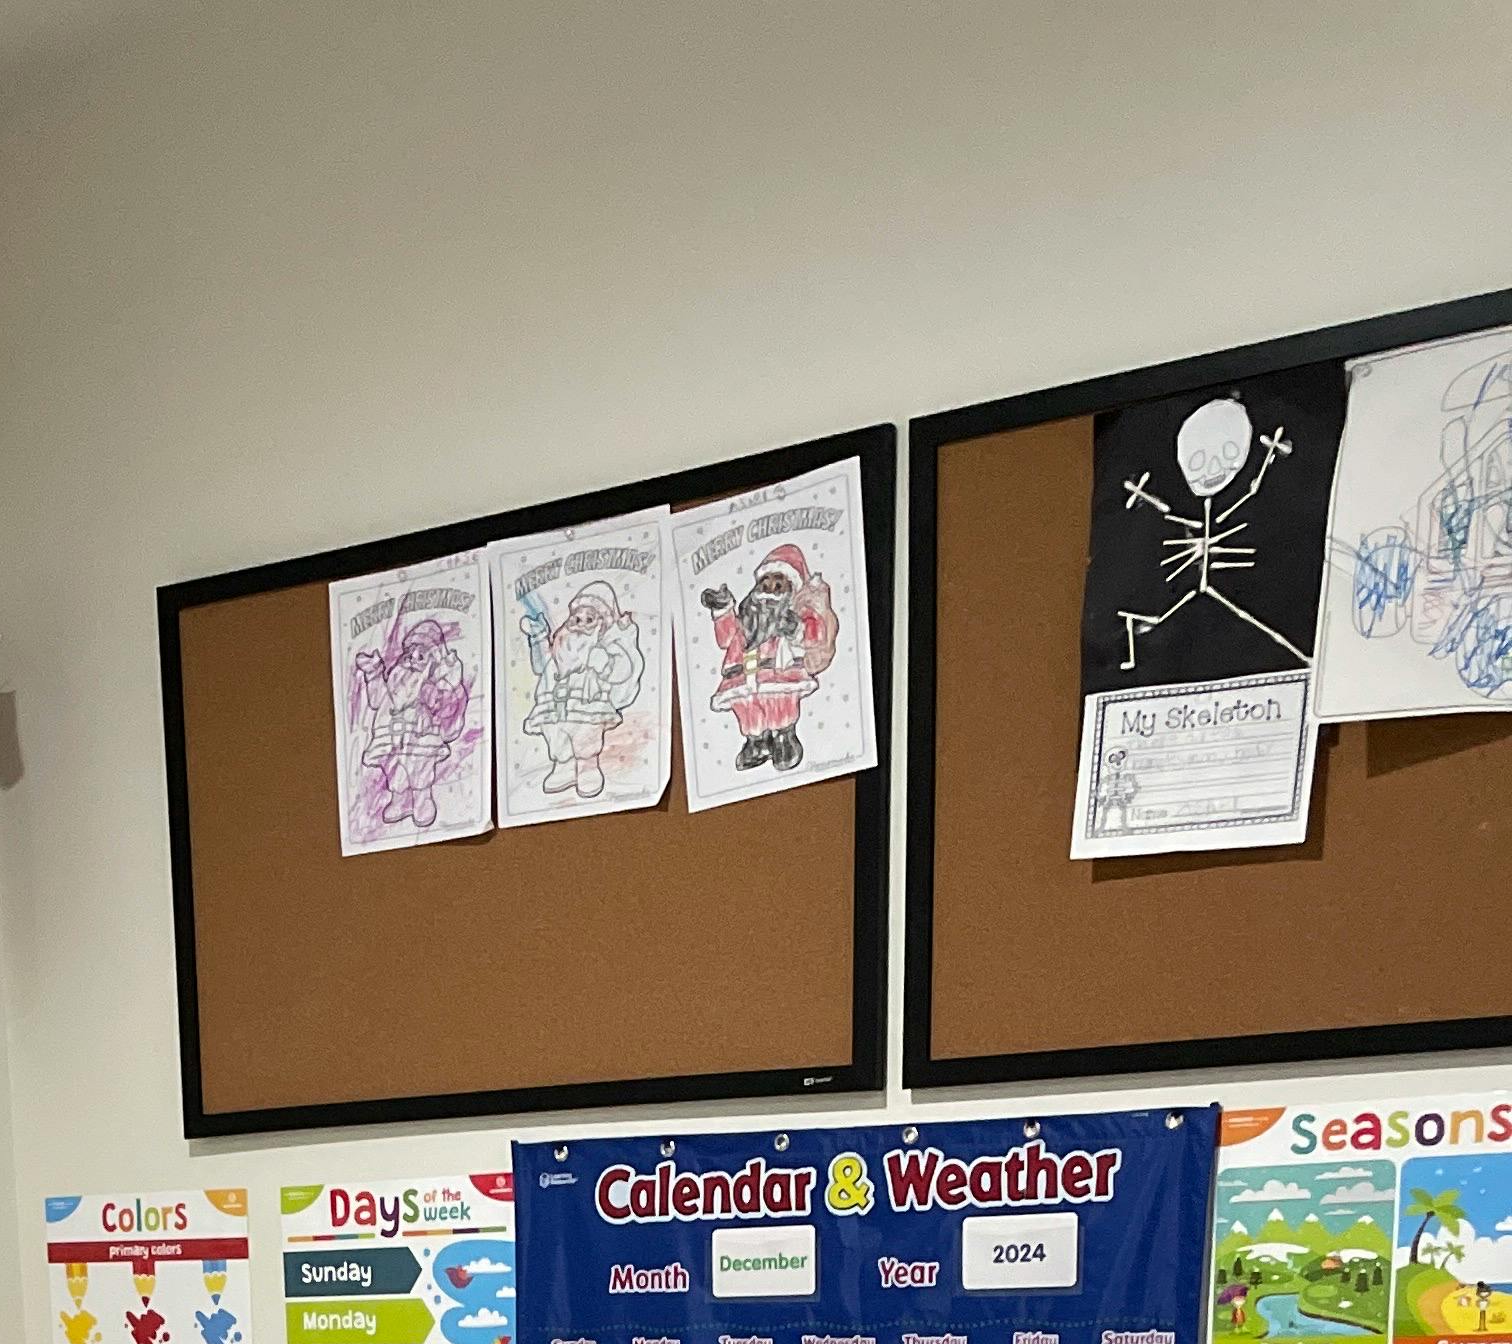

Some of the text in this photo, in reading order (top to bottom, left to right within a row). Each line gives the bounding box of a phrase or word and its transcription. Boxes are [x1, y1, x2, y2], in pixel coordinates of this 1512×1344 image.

[691, 506, 844, 576] MERRY CHRISTMAS!
[515, 548, 656, 598] MERRY CHRISTMAS!
[350, 588, 475, 639] MERRY CHRISTMAS!
[1121, 698, 1281, 738] My Skeleton
[1290, 1104, 1512, 1155] Seasons
[596, 1141, 1119, 1223] Calendar & Weather
[102, 1198, 187, 1232] Colors
[330, 1188, 461, 1237] Days of the
[423, 1202, 471, 1222] week
[109, 1243, 182, 1260] primary colors
[301, 1261, 372, 1287] Sunday
[610, 1244, 1046, 1293] Month December Year 2024
[303, 1311, 376, 1335] Monday
